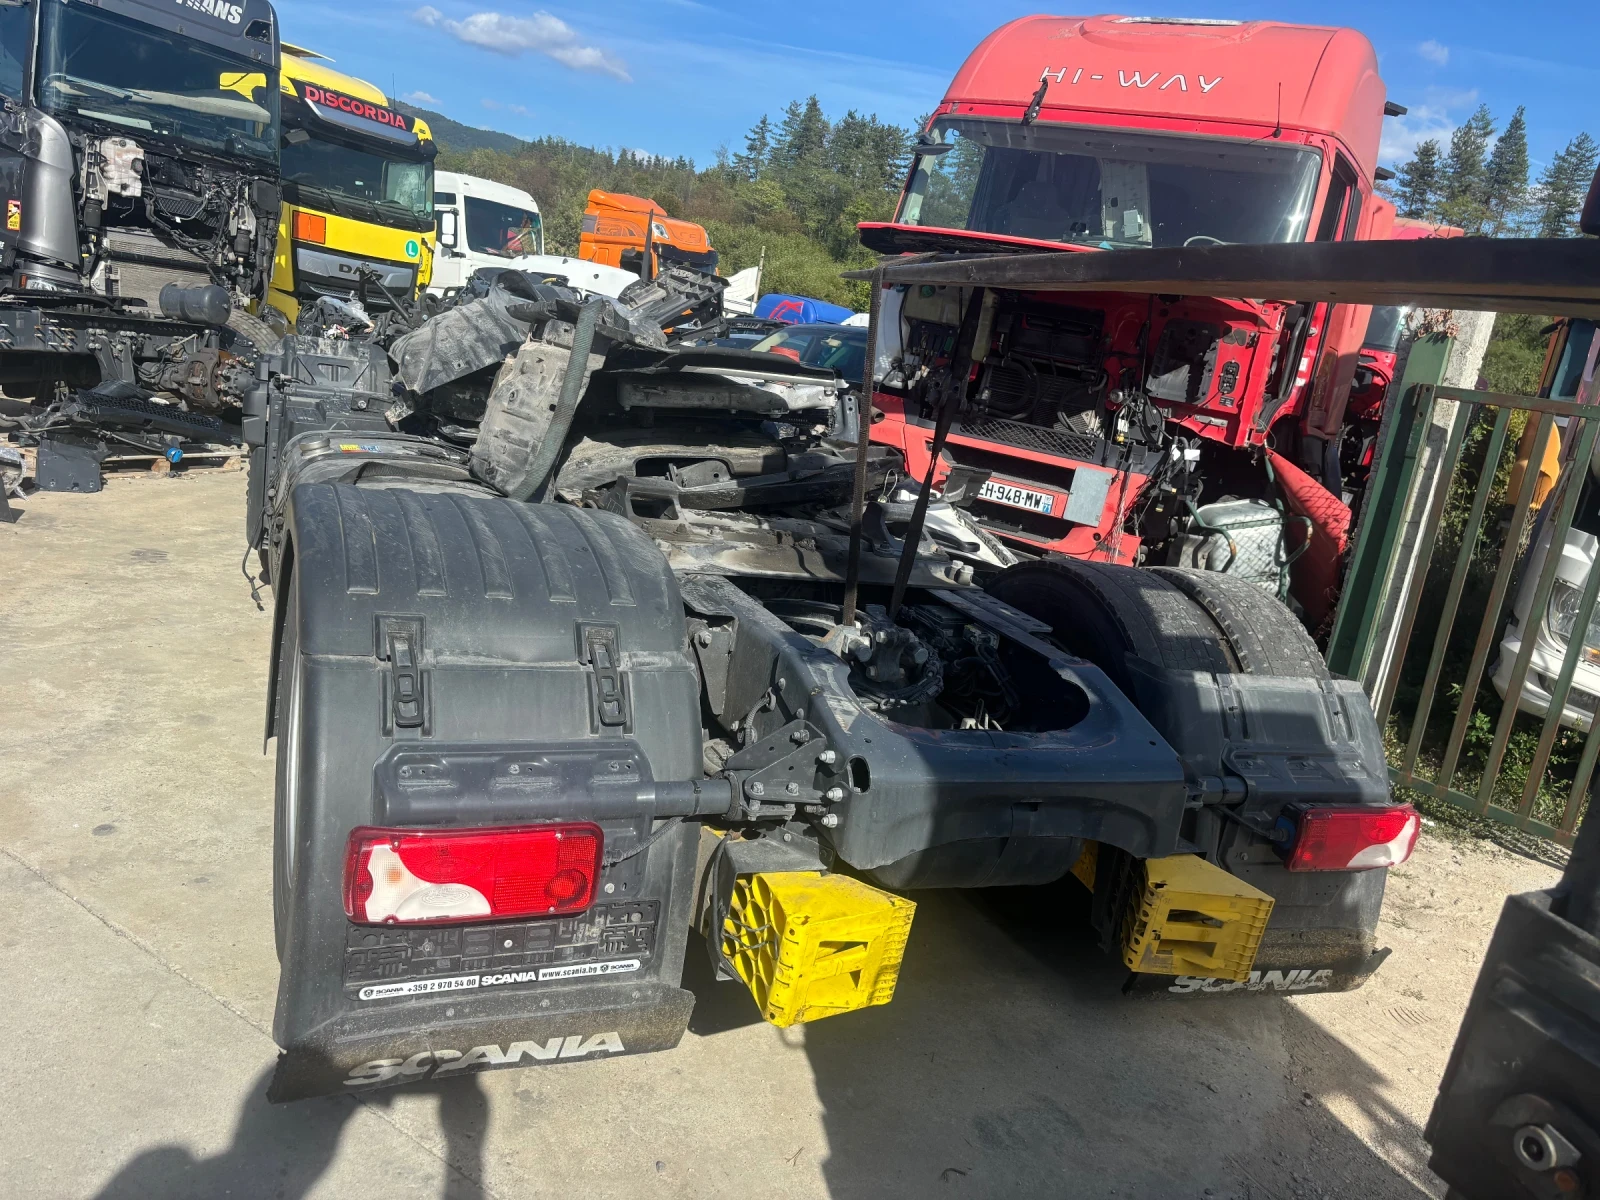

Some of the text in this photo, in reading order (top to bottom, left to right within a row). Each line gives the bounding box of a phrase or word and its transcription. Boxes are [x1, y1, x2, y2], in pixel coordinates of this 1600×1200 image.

[1039, 66, 1225, 94] HI-WAY
[305, 85, 407, 130] DISCORDIA
[408, 243, 416, 256] L
[407, 983, 428, 993] +359
[430, 982, 435, 990] 2
[437, 980, 452, 989] 970
[454, 979, 464, 987] 54
[466, 978, 476, 986] 00
[481, 971, 537, 986] SCANIA
[541, 965, 598, 979] www.scania.bg
[342, 1031, 626, 1086] SCANIA
